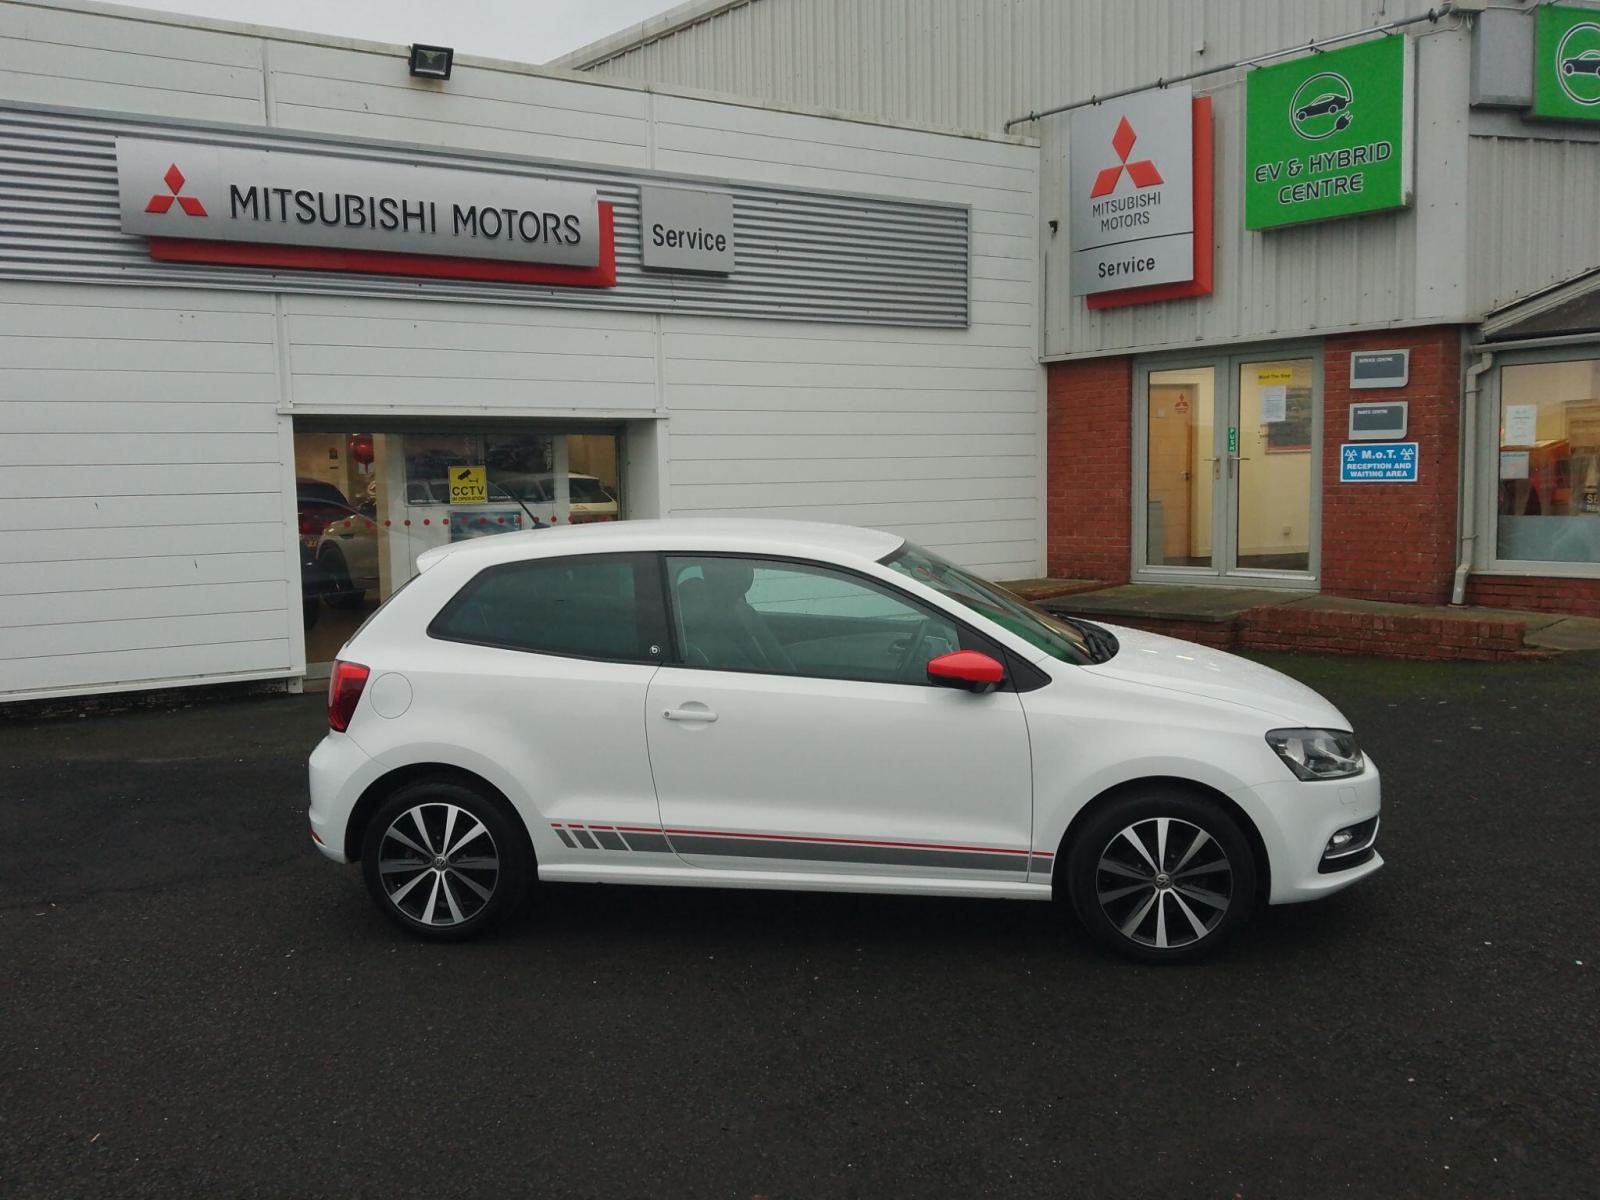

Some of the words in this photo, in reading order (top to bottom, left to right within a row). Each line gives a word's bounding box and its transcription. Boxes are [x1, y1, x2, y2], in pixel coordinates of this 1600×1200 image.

[1254, 161, 1284, 183] EV
[1287, 158, 1303, 178] &
[1309, 140, 1393, 174] HYBRID
[1278, 172, 1364, 204] CENTRE
[230, 184, 436, 233] MITSUBISHI
[453, 203, 581, 246] MOTORS
[1092, 191, 1161, 217] MITSUBISHI
[1101, 211, 1150, 233] MOTORS
[652, 223, 727, 253] Service
[1098, 256, 1155, 278] Service
[1361, 449, 1397, 459] M.o.T.
[452, 486, 484, 496] CCTV
